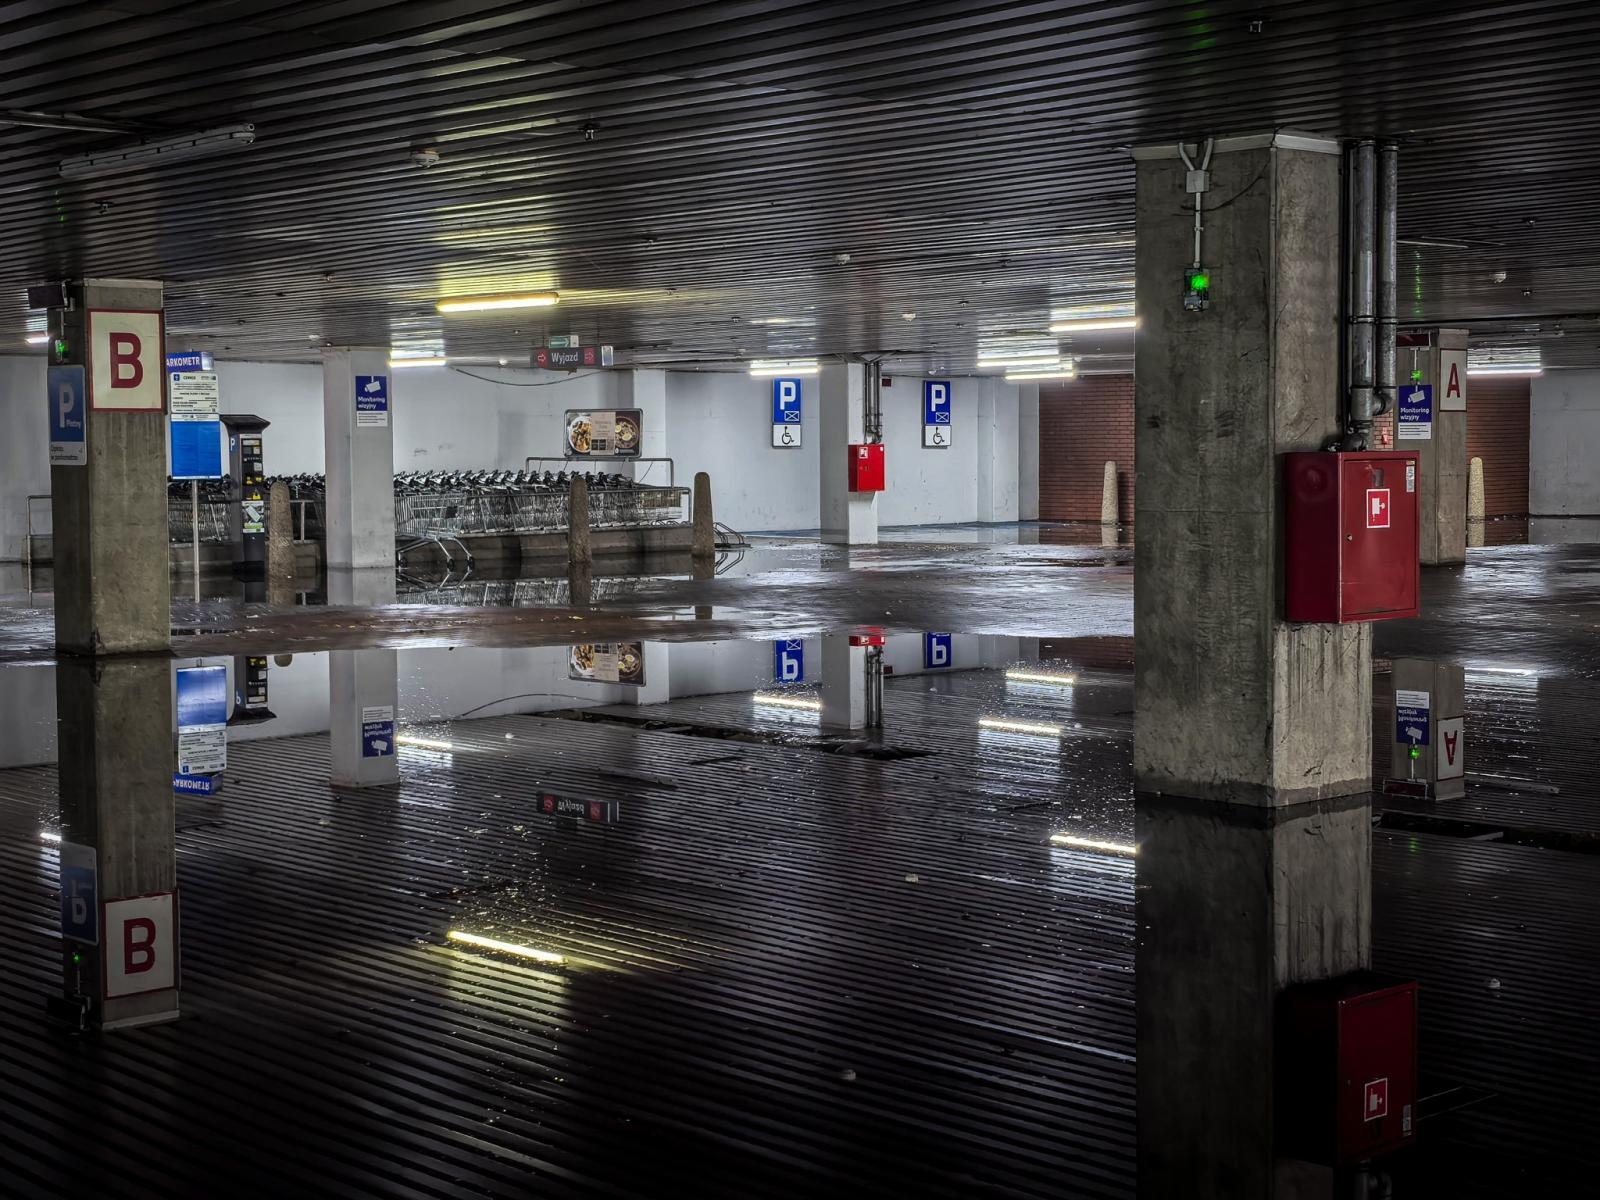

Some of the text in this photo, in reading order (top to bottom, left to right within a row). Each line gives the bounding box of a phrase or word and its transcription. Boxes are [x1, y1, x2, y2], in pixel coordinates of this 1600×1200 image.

[109, 332, 144, 389] B
[551, 352, 579, 364] Wyjazd
[1446, 362, 1461, 398] A
[59, 383, 75, 428] P
[779, 381, 797, 410] P
[931, 384, 946, 412] P
[230, 438, 236, 451] P
